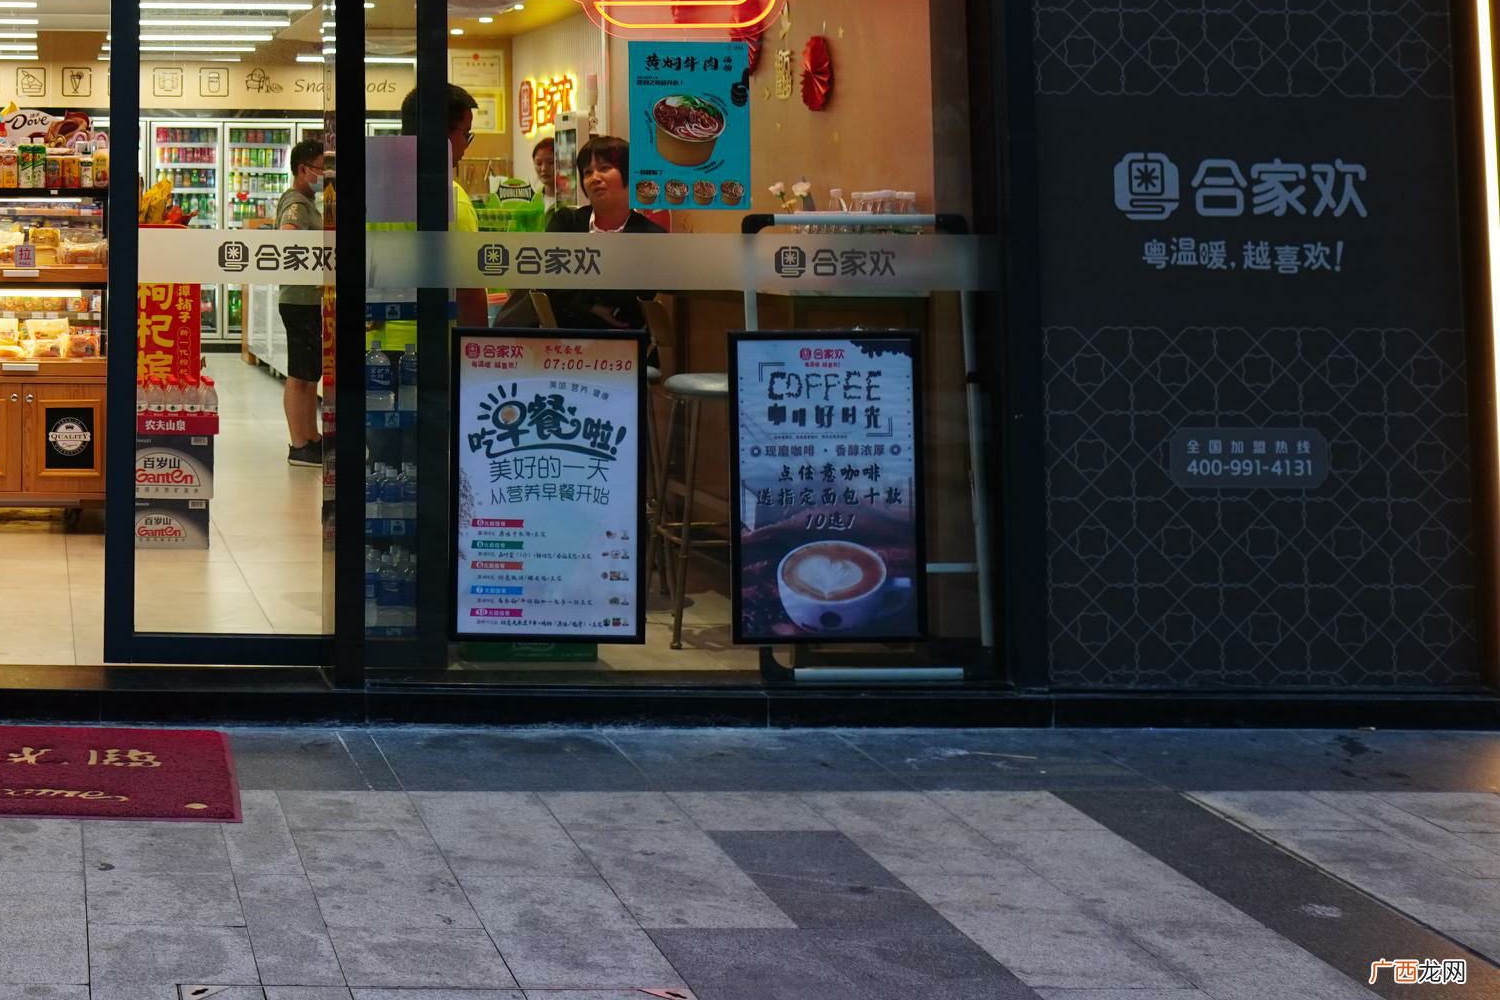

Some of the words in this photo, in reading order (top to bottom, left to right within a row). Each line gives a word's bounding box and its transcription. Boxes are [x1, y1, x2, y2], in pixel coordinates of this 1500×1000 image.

[5, 113, 49, 130] Dove
[1190, 157, 1369, 218] 合家欢
[514, 246, 602, 276] 合家欢
[811, 248, 897, 278] 合家欢
[483, 345, 524, 359] 合家欢
[543, 358, 632, 371] 07:00-10:30
[145, 419, 187, 431] 农夫山泉
[1186, 439, 1312, 456] 全国加盟热线
[144, 457, 181, 469] 百岁山
[489, 456, 610, 483] 美好的一天
[1186, 459, 1313, 477] 400-991-4131
[778, 462, 881, 482] 点任意咖啡
[490, 482, 611, 505] 从营养早餐开始
[144, 516, 172, 526] 百岁山
